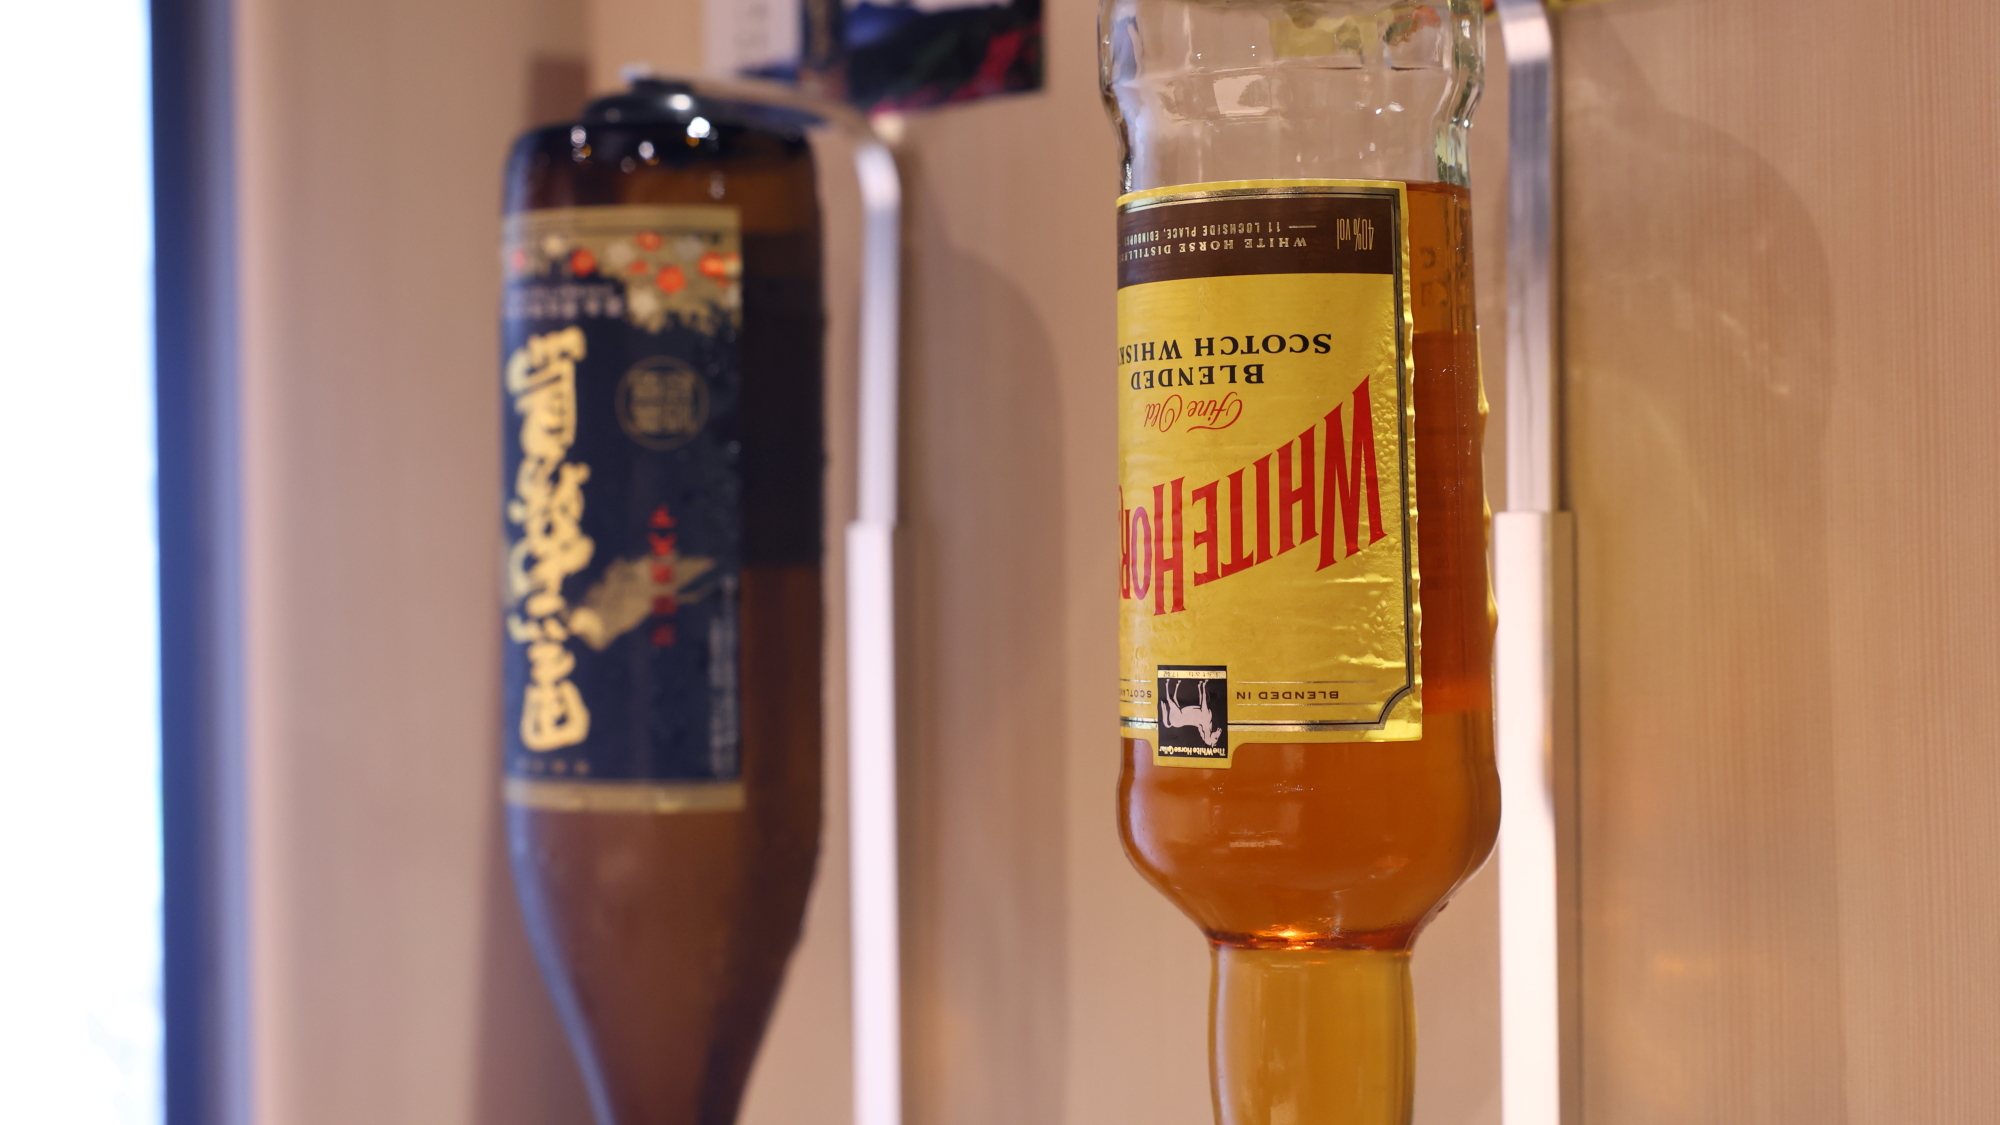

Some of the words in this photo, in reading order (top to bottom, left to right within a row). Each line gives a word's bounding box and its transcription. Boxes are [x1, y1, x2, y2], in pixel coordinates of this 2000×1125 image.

[1163, 226, 1197, 240] PLACE,
[1202, 222, 1261, 235] LOCHSIDE
[1268, 221, 1281, 233] 11
[1336, 218, 1351, 250] vol
[1352, 217, 1375, 251] 40%
[1178, 239, 1234, 253] HORSE
[1243, 237, 1308, 249] WHITE
[1194, 333, 1332, 357] SCOTCH
[1118, 339, 1183, 366] WHISK
[1130, 363, 1265, 390] BLENDED
[1143, 394, 1183, 433] Old
[1186, 391, 1243, 433] Fine
[1119, 475, 1187, 617] HOR
[1236, 691, 1252, 700] IN
[1258, 690, 1340, 700] BLENDED
[1174, 746, 1193, 756] Horse
[1193, 746, 1213, 756] White
[1212, 747, 1226, 757] The
